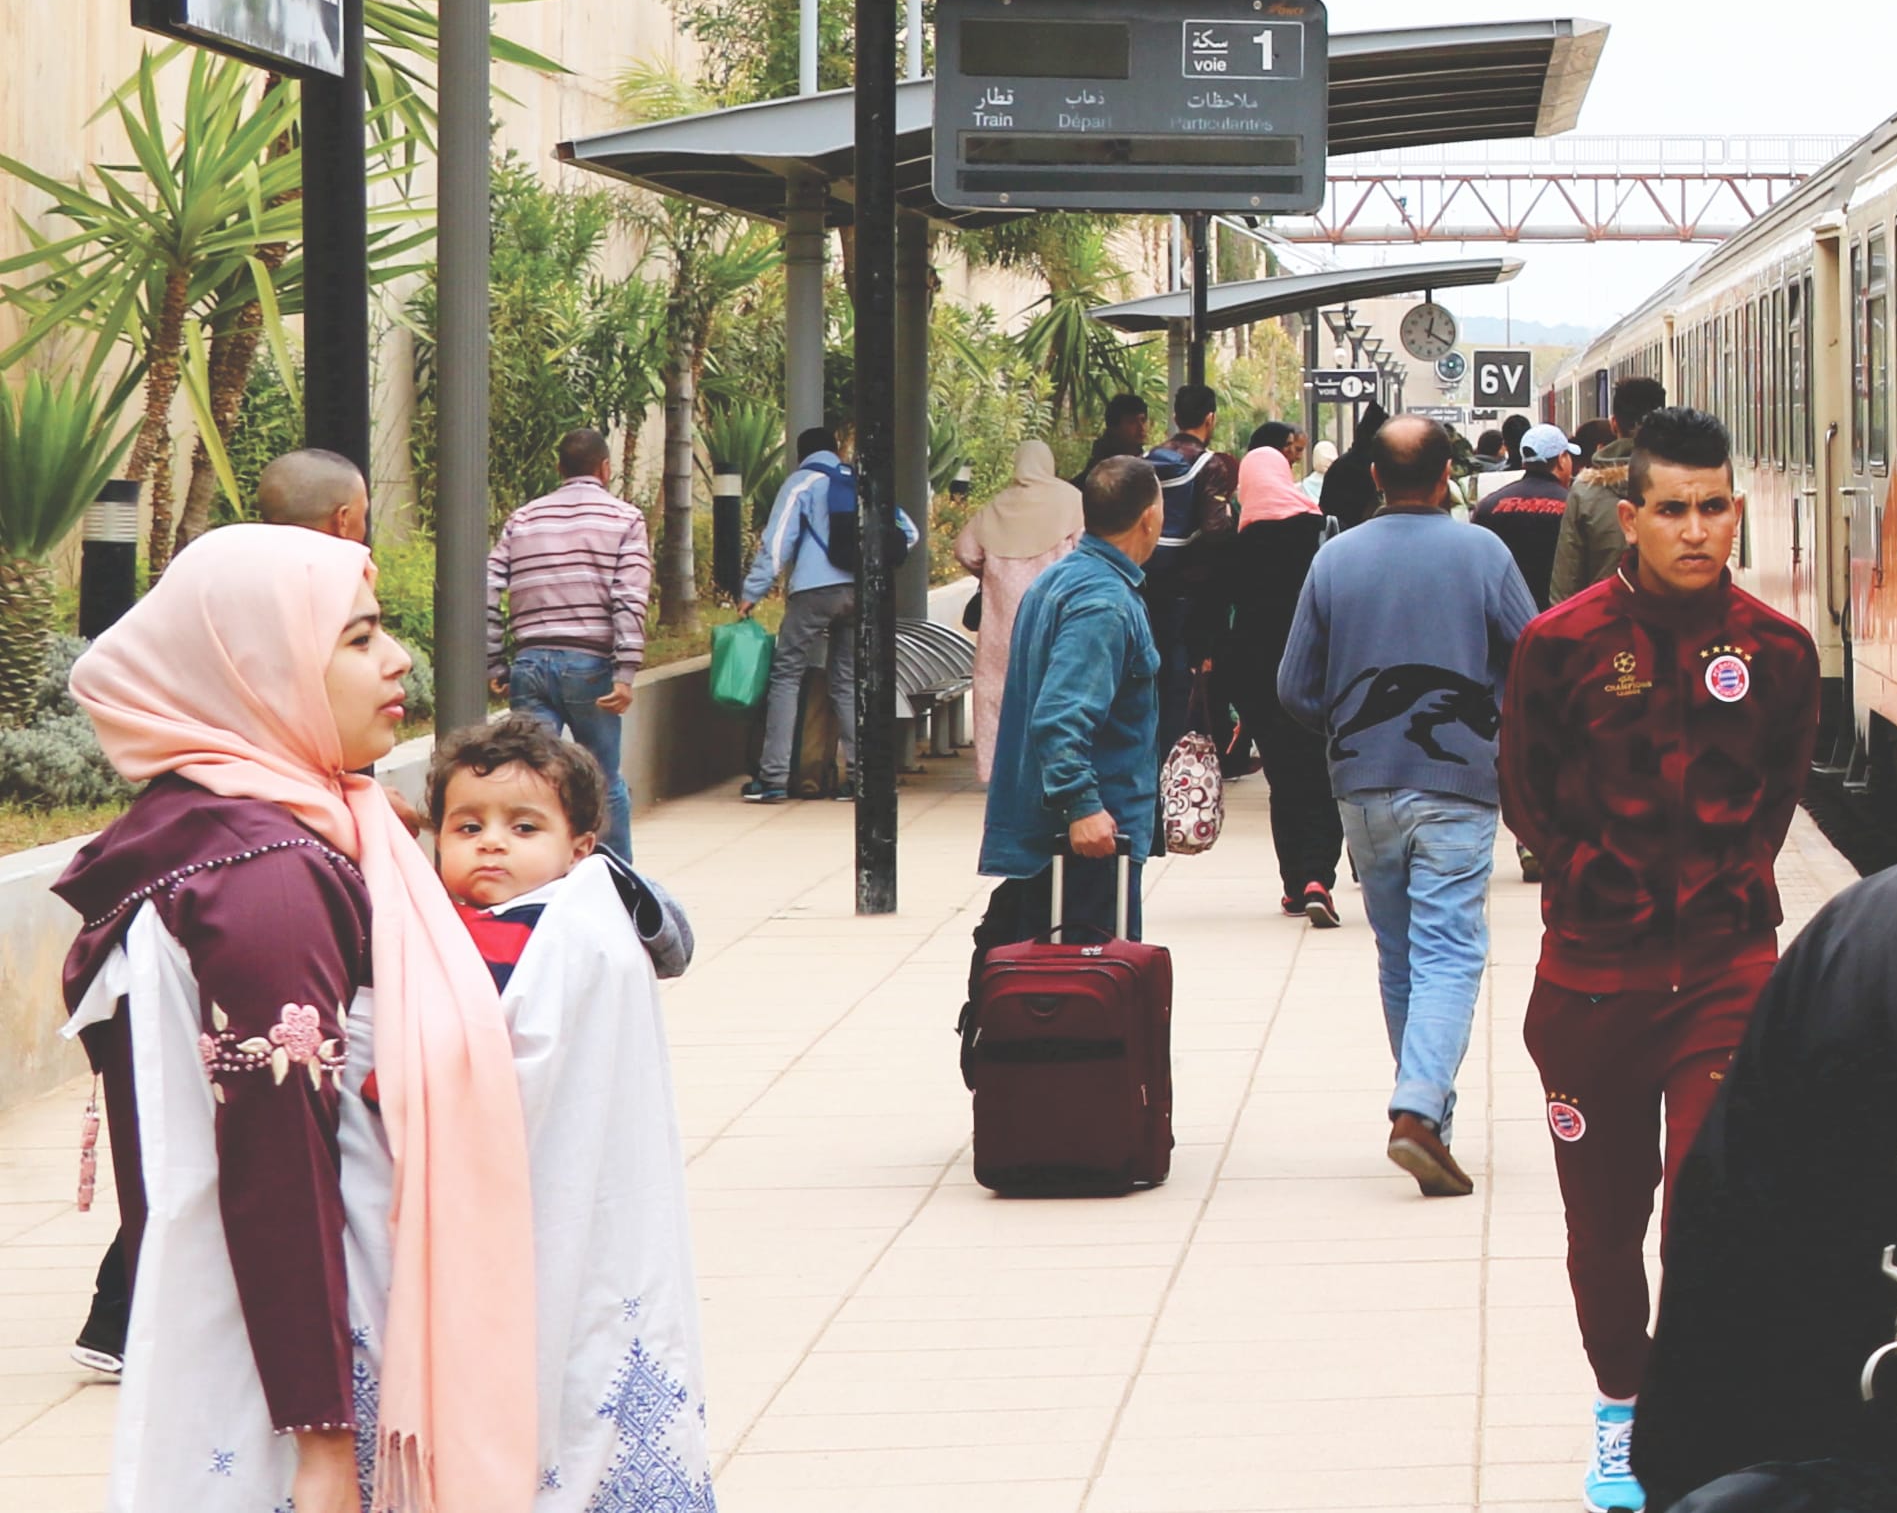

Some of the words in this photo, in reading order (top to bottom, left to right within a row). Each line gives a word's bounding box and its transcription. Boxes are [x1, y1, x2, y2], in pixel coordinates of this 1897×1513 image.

[1192, 29, 1229, 48] سكة
[1253, 29, 1272, 71] 1
[1193, 56, 1227, 72] voie
[975, 86, 1014, 110] قطار
[1065, 89, 1105, 110] ذهاب
[1187, 90, 1259, 109] ملاحظات
[973, 112, 1014, 127] Train
[1480, 363, 1524, 394] 6V
